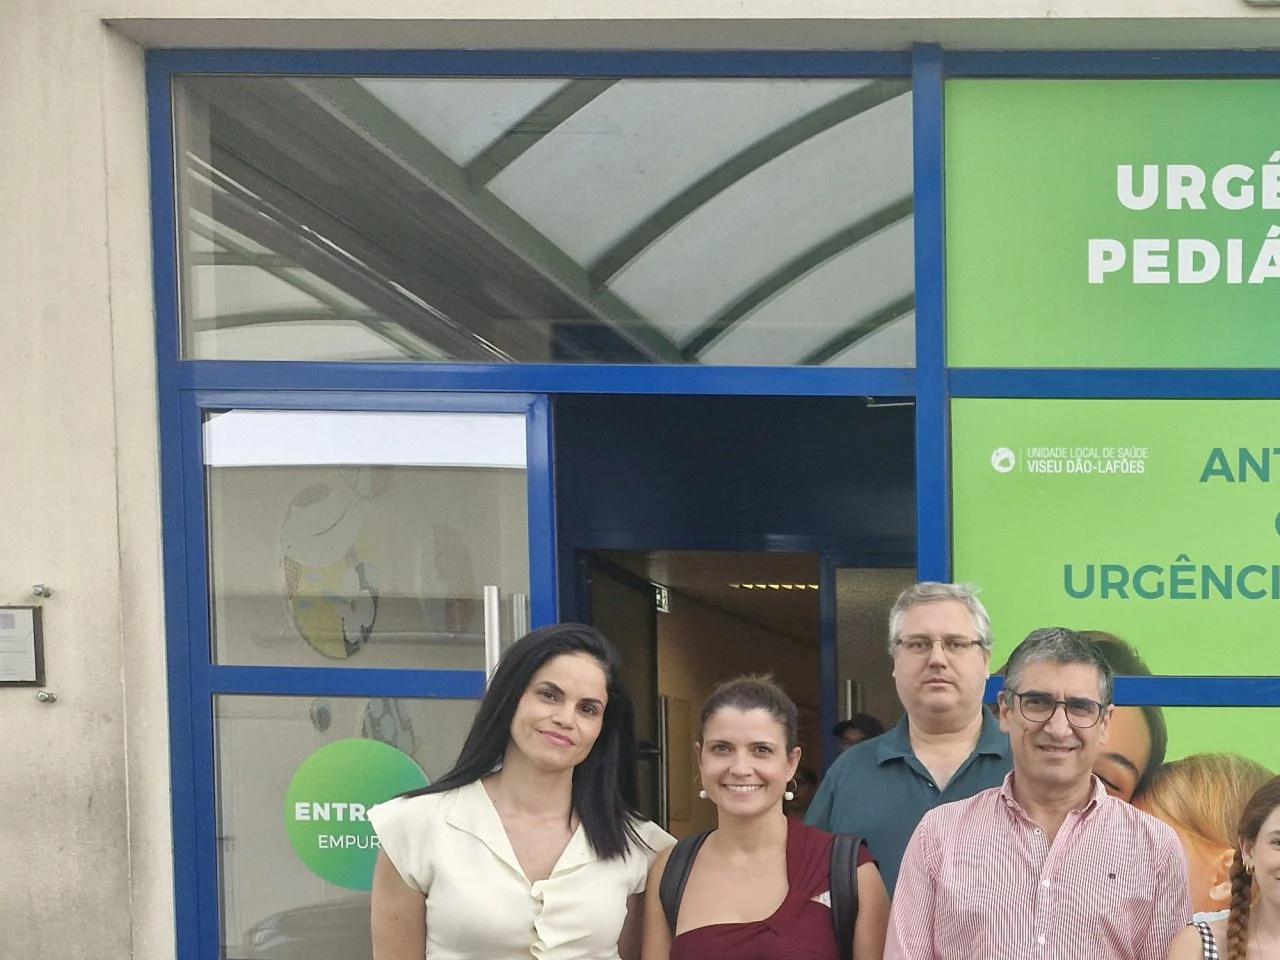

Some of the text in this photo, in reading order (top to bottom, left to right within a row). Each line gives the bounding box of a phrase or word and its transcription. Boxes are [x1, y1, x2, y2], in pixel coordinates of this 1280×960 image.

[1027, 445, 1149, 459] UNIDADE LOCAL DE SAÚDE
[1027, 458, 1145, 474] VISEU DÃO-LAFÕES
[295, 802, 371, 822] ENTR
